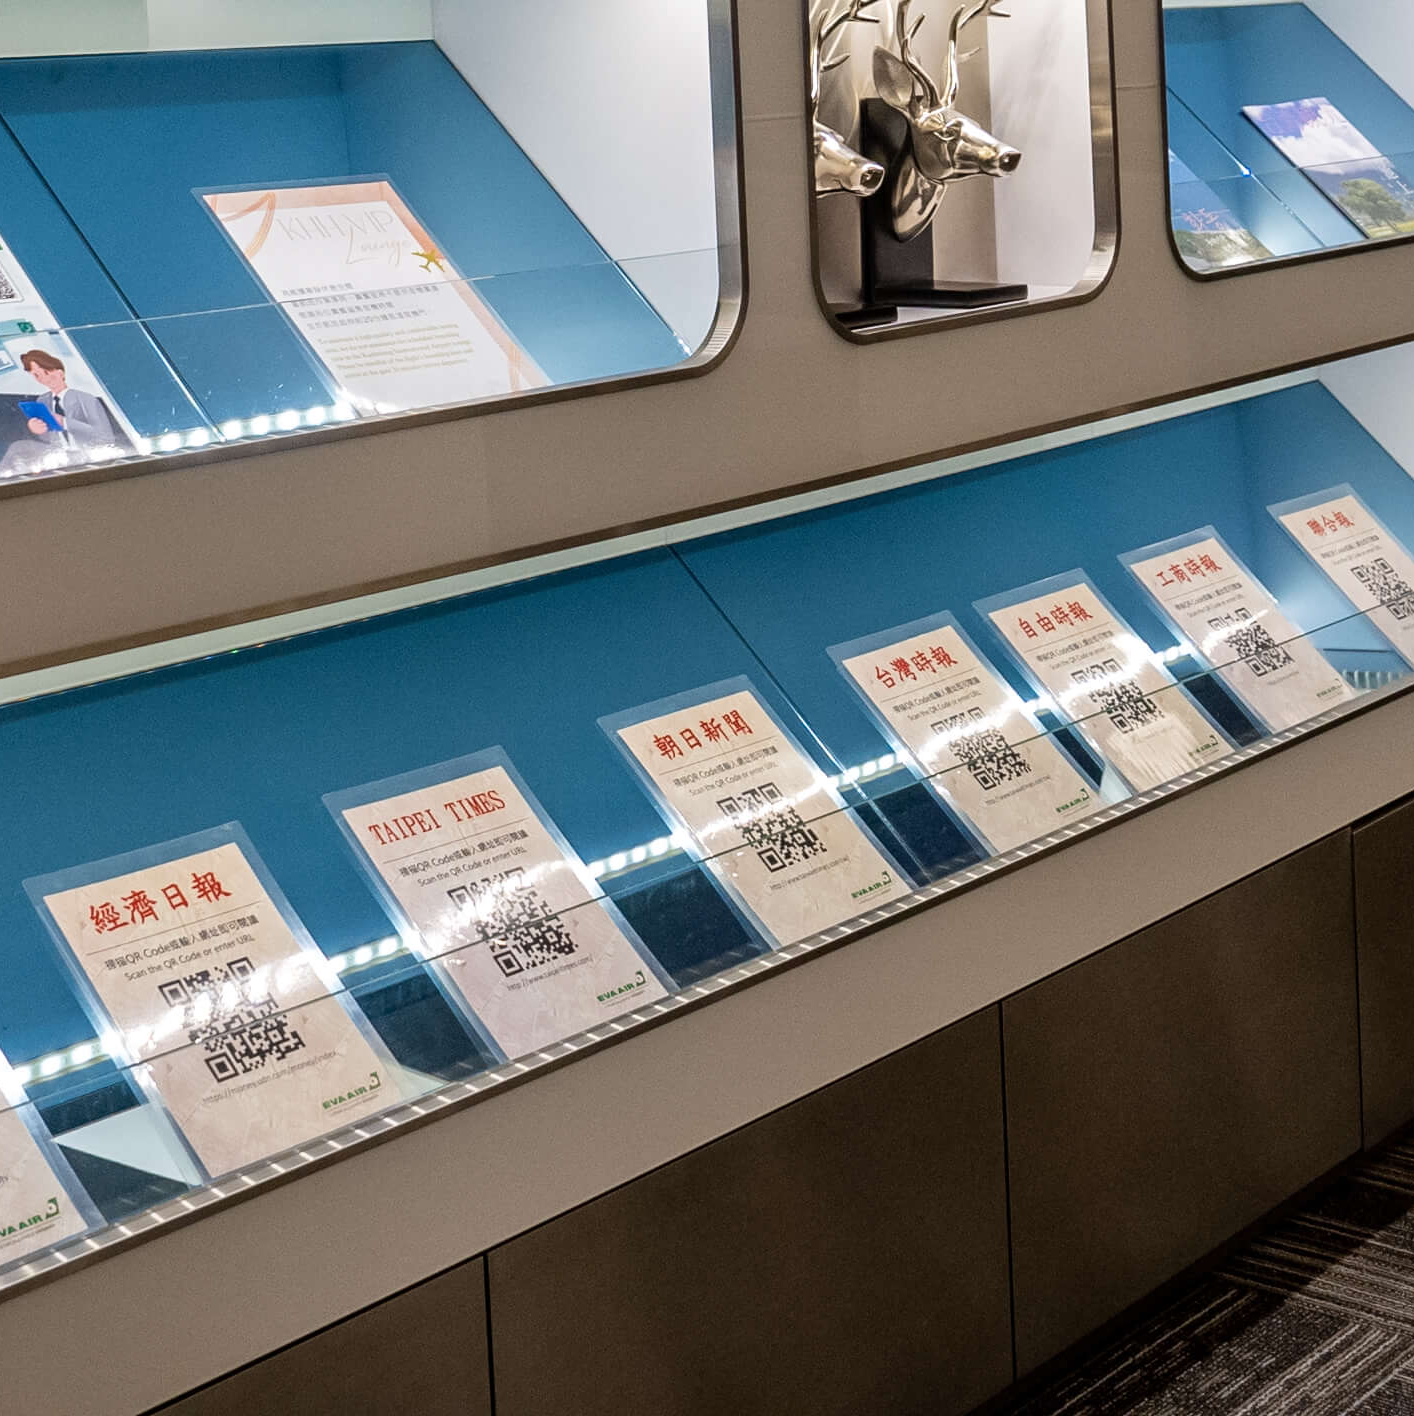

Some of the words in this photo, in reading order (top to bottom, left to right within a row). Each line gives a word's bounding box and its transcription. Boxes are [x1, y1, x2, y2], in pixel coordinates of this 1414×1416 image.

[1018, 601, 1094, 639] 自由時報
[875, 645, 959, 689] 台灣時報
[653, 709, 754, 760] 朝日新聞
[368, 809, 442, 846] TAIPEI
[444, 790, 506, 823] TIMES
[449, 866, 462, 877] QR
[462, 860, 482, 872] Code
[88, 871, 233, 935] 經濟日報
[124, 970, 148, 982] Scan
[148, 964, 164, 974] the
[163, 958, 177, 970] QR
[178, 950, 201, 963] Code
[203, 947, 212, 955] or
[214, 941, 237, 953] enter
[237, 934, 256, 945] URL
[596, 989, 618, 1002] EVA
[19, 1214, 44, 1231] AIR
